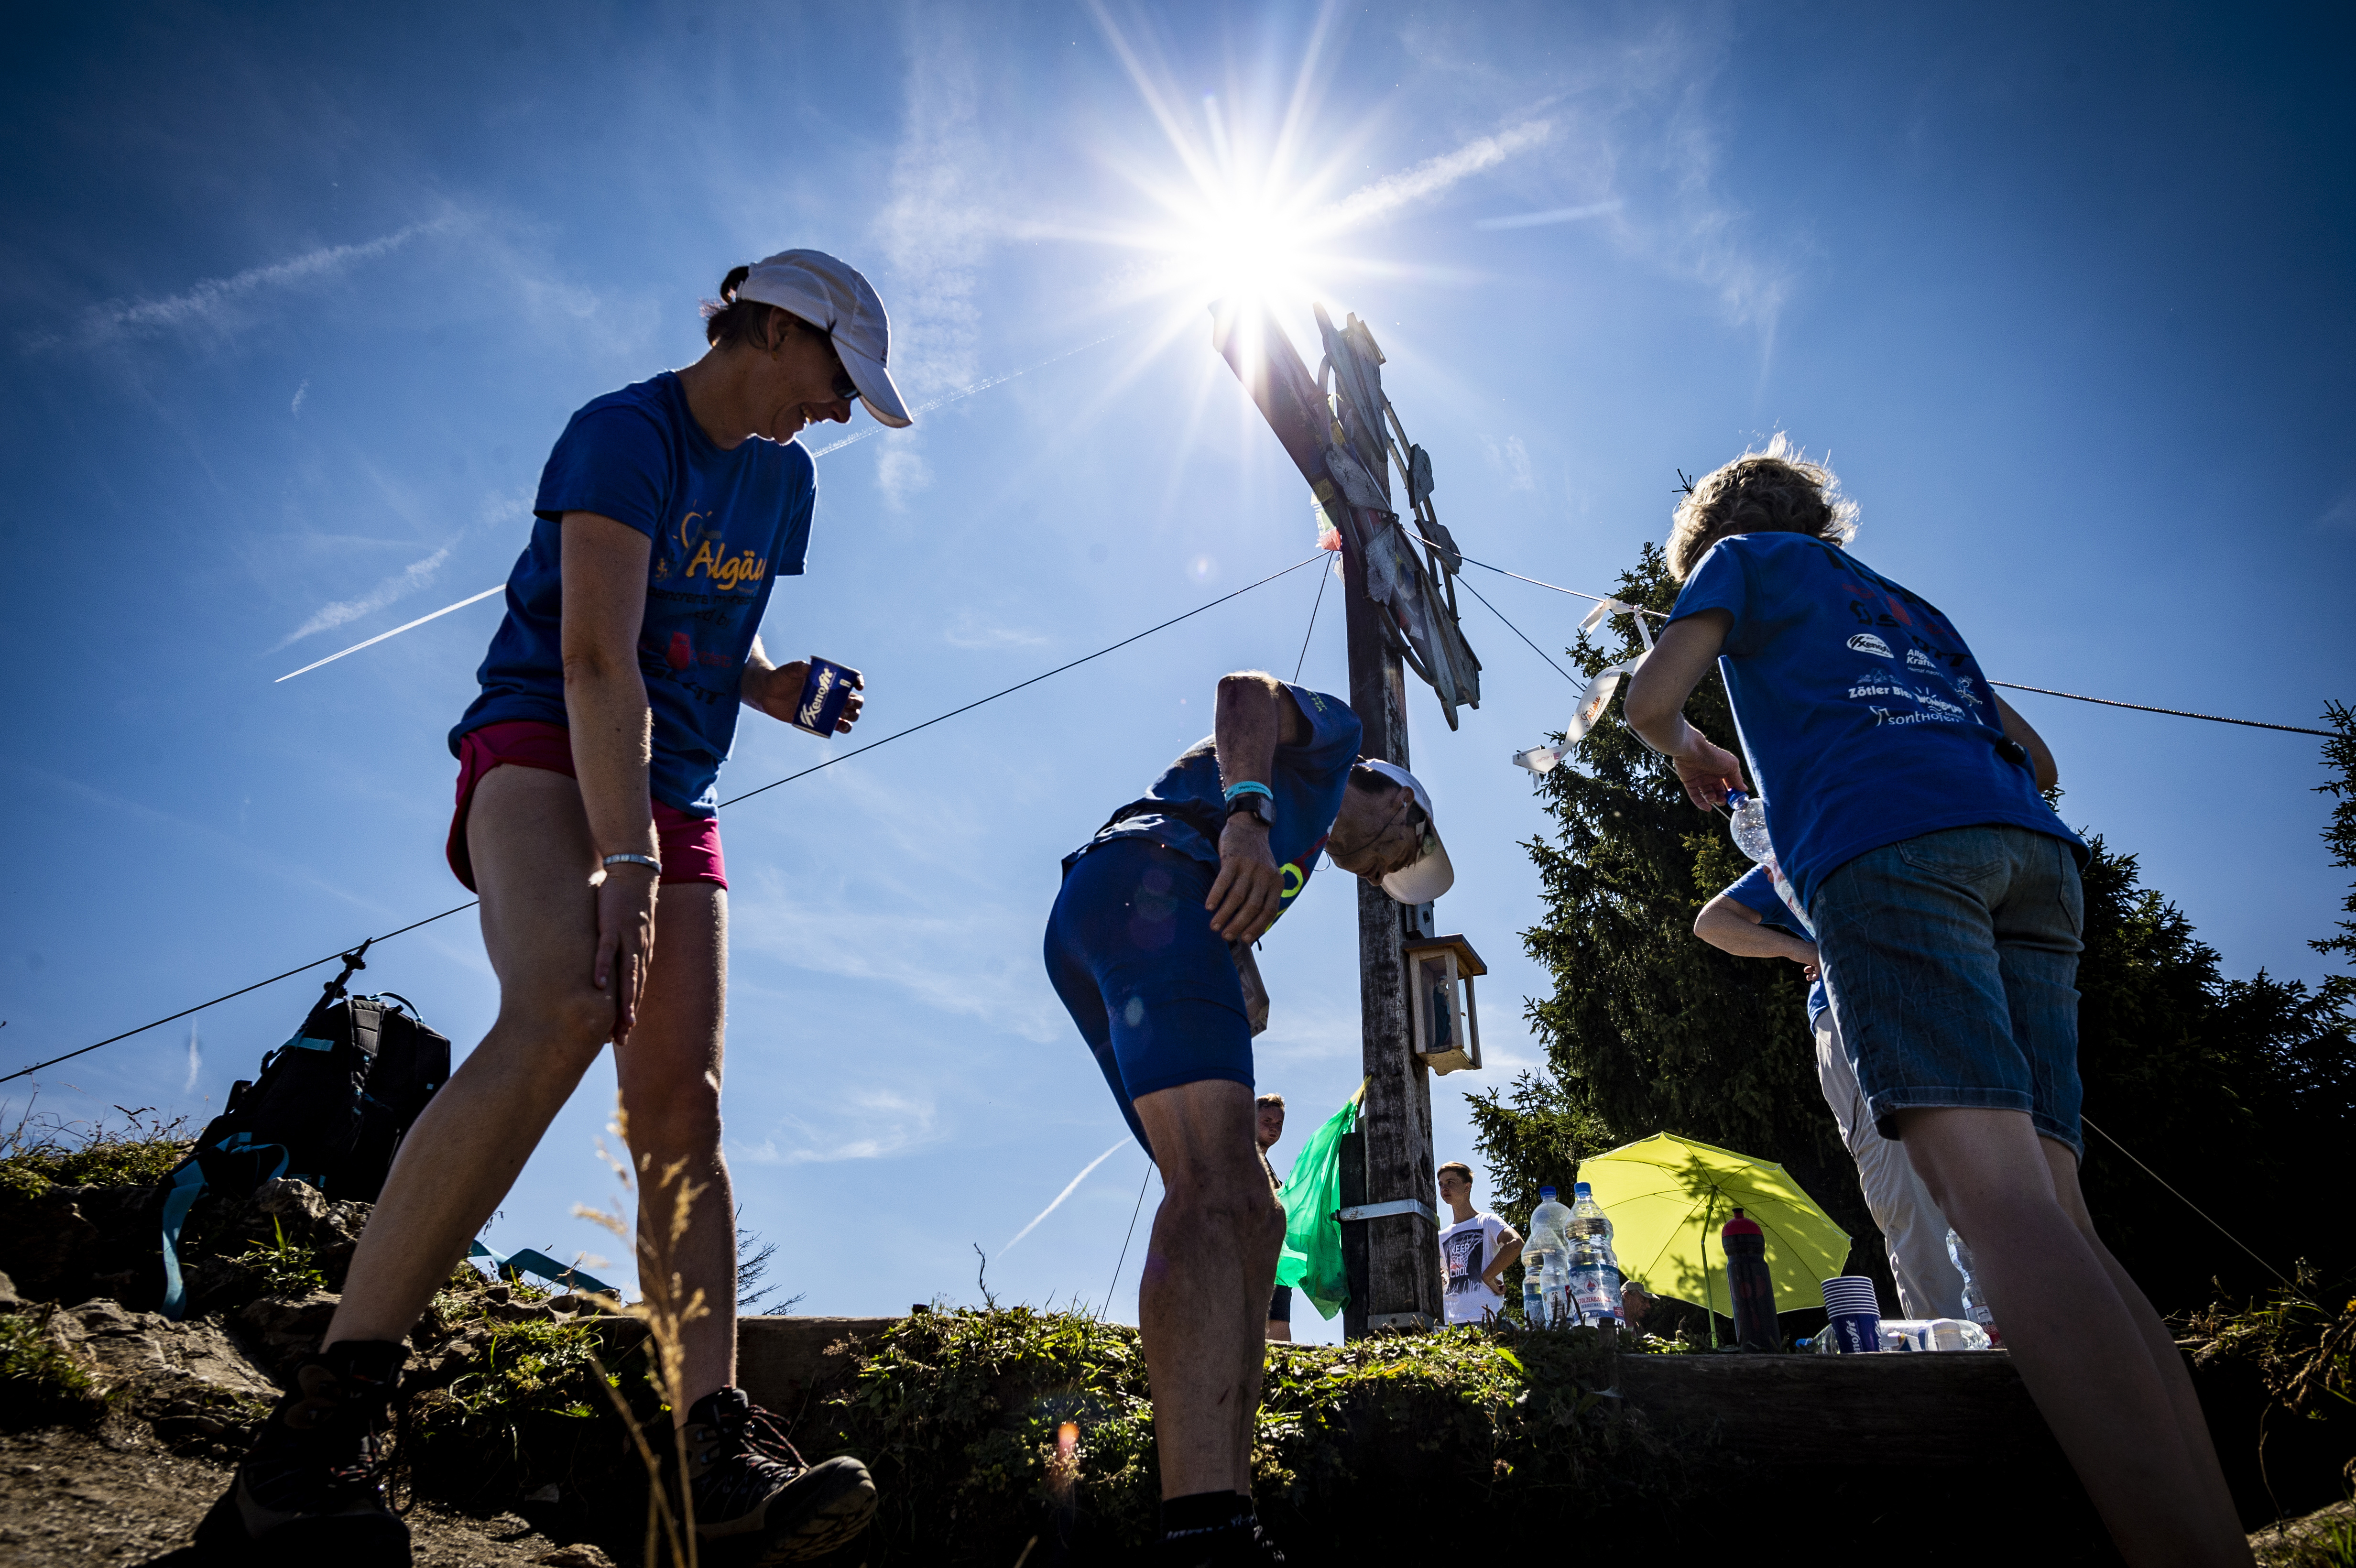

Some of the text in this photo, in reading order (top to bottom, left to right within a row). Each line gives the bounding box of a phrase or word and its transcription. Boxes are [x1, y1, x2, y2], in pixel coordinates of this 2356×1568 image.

[1848, 686, 1913, 699] Zötler Bie
[1451, 1243, 1470, 1255] KEEP
[1450, 1266, 1469, 1278] COOL
